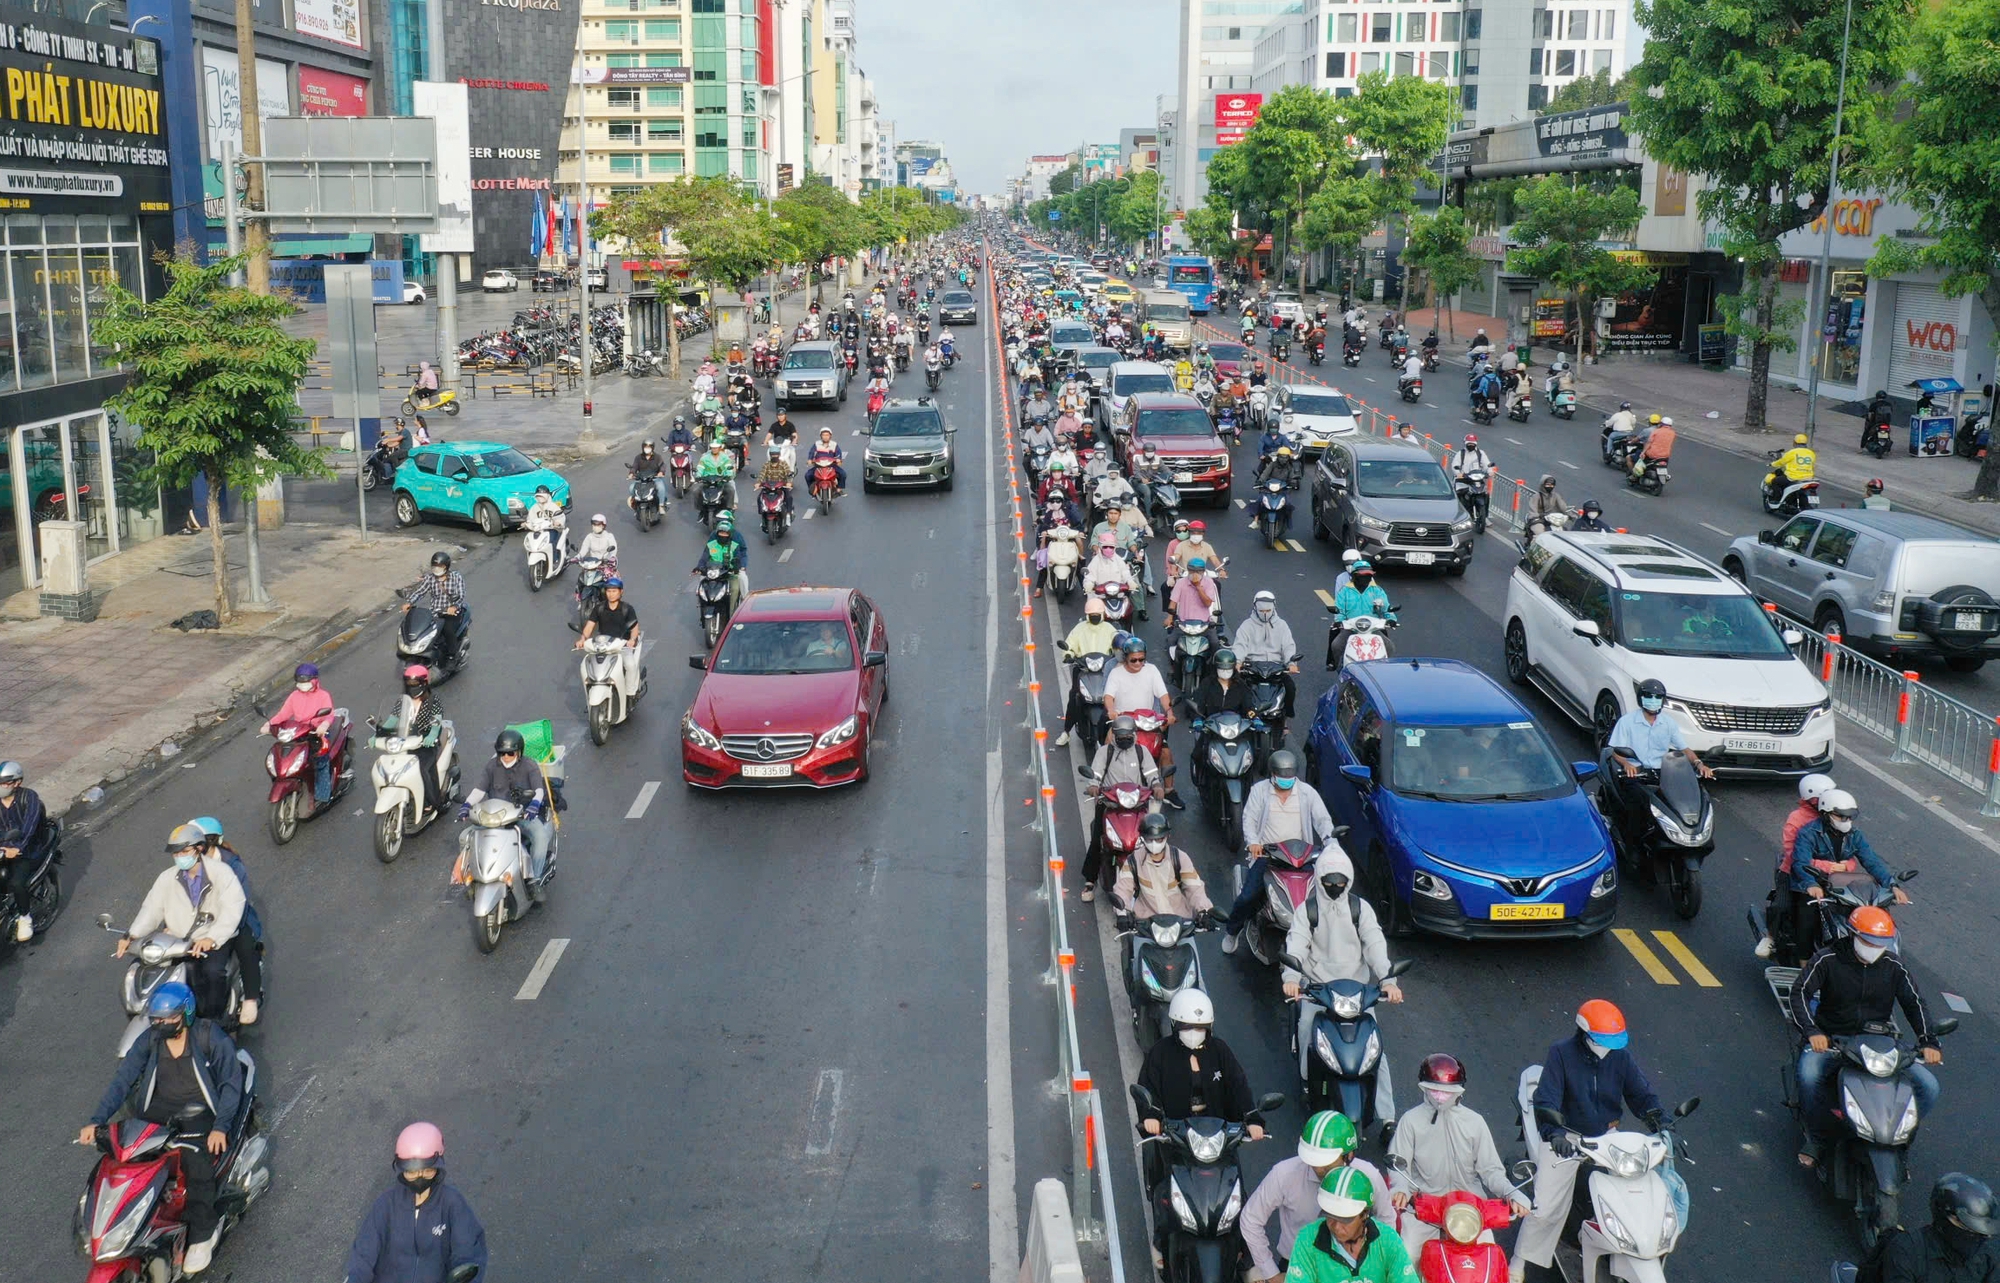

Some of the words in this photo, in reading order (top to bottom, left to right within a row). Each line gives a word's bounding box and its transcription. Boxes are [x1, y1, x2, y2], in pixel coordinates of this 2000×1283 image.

[8, 25, 16, 49] 8
[24, 24, 50, 55] CÔNG
[50, 33, 60, 57] TY
[62, 36, 86, 62] TNHH
[86, 40, 99, 64] SX
[104, 44, 118, 68] TM
[122, 48, 134, 70] DV
[468, 78, 503, 90] LOTTE
[506, 80, 550, 92] CINEMA
[6, 63, 70, 126] PHÁT
[77, 78, 159, 135] LUXURY
[24, 133, 40, 158] VÀ
[39, 135, 65, 164] NHẬP
[66, 134, 92, 162] KHẨU
[92, 139, 107, 166] NỘI
[108, 138, 130, 164] THẤT
[130, 141, 148, 165] GHẾ
[148, 148, 168, 166] SOFA
[498, 148, 542, 160] HOUSE
[8, 174, 114, 194] www.hungphatluxury.vn
[472, 178, 516, 190] LOTTE
[516, 177, 550, 190] Mart
[1796, 454, 1812, 465] be
[1728, 740, 1776, 750] 51K-861.61
[1496, 904, 1558, 917] 50E-427.14
